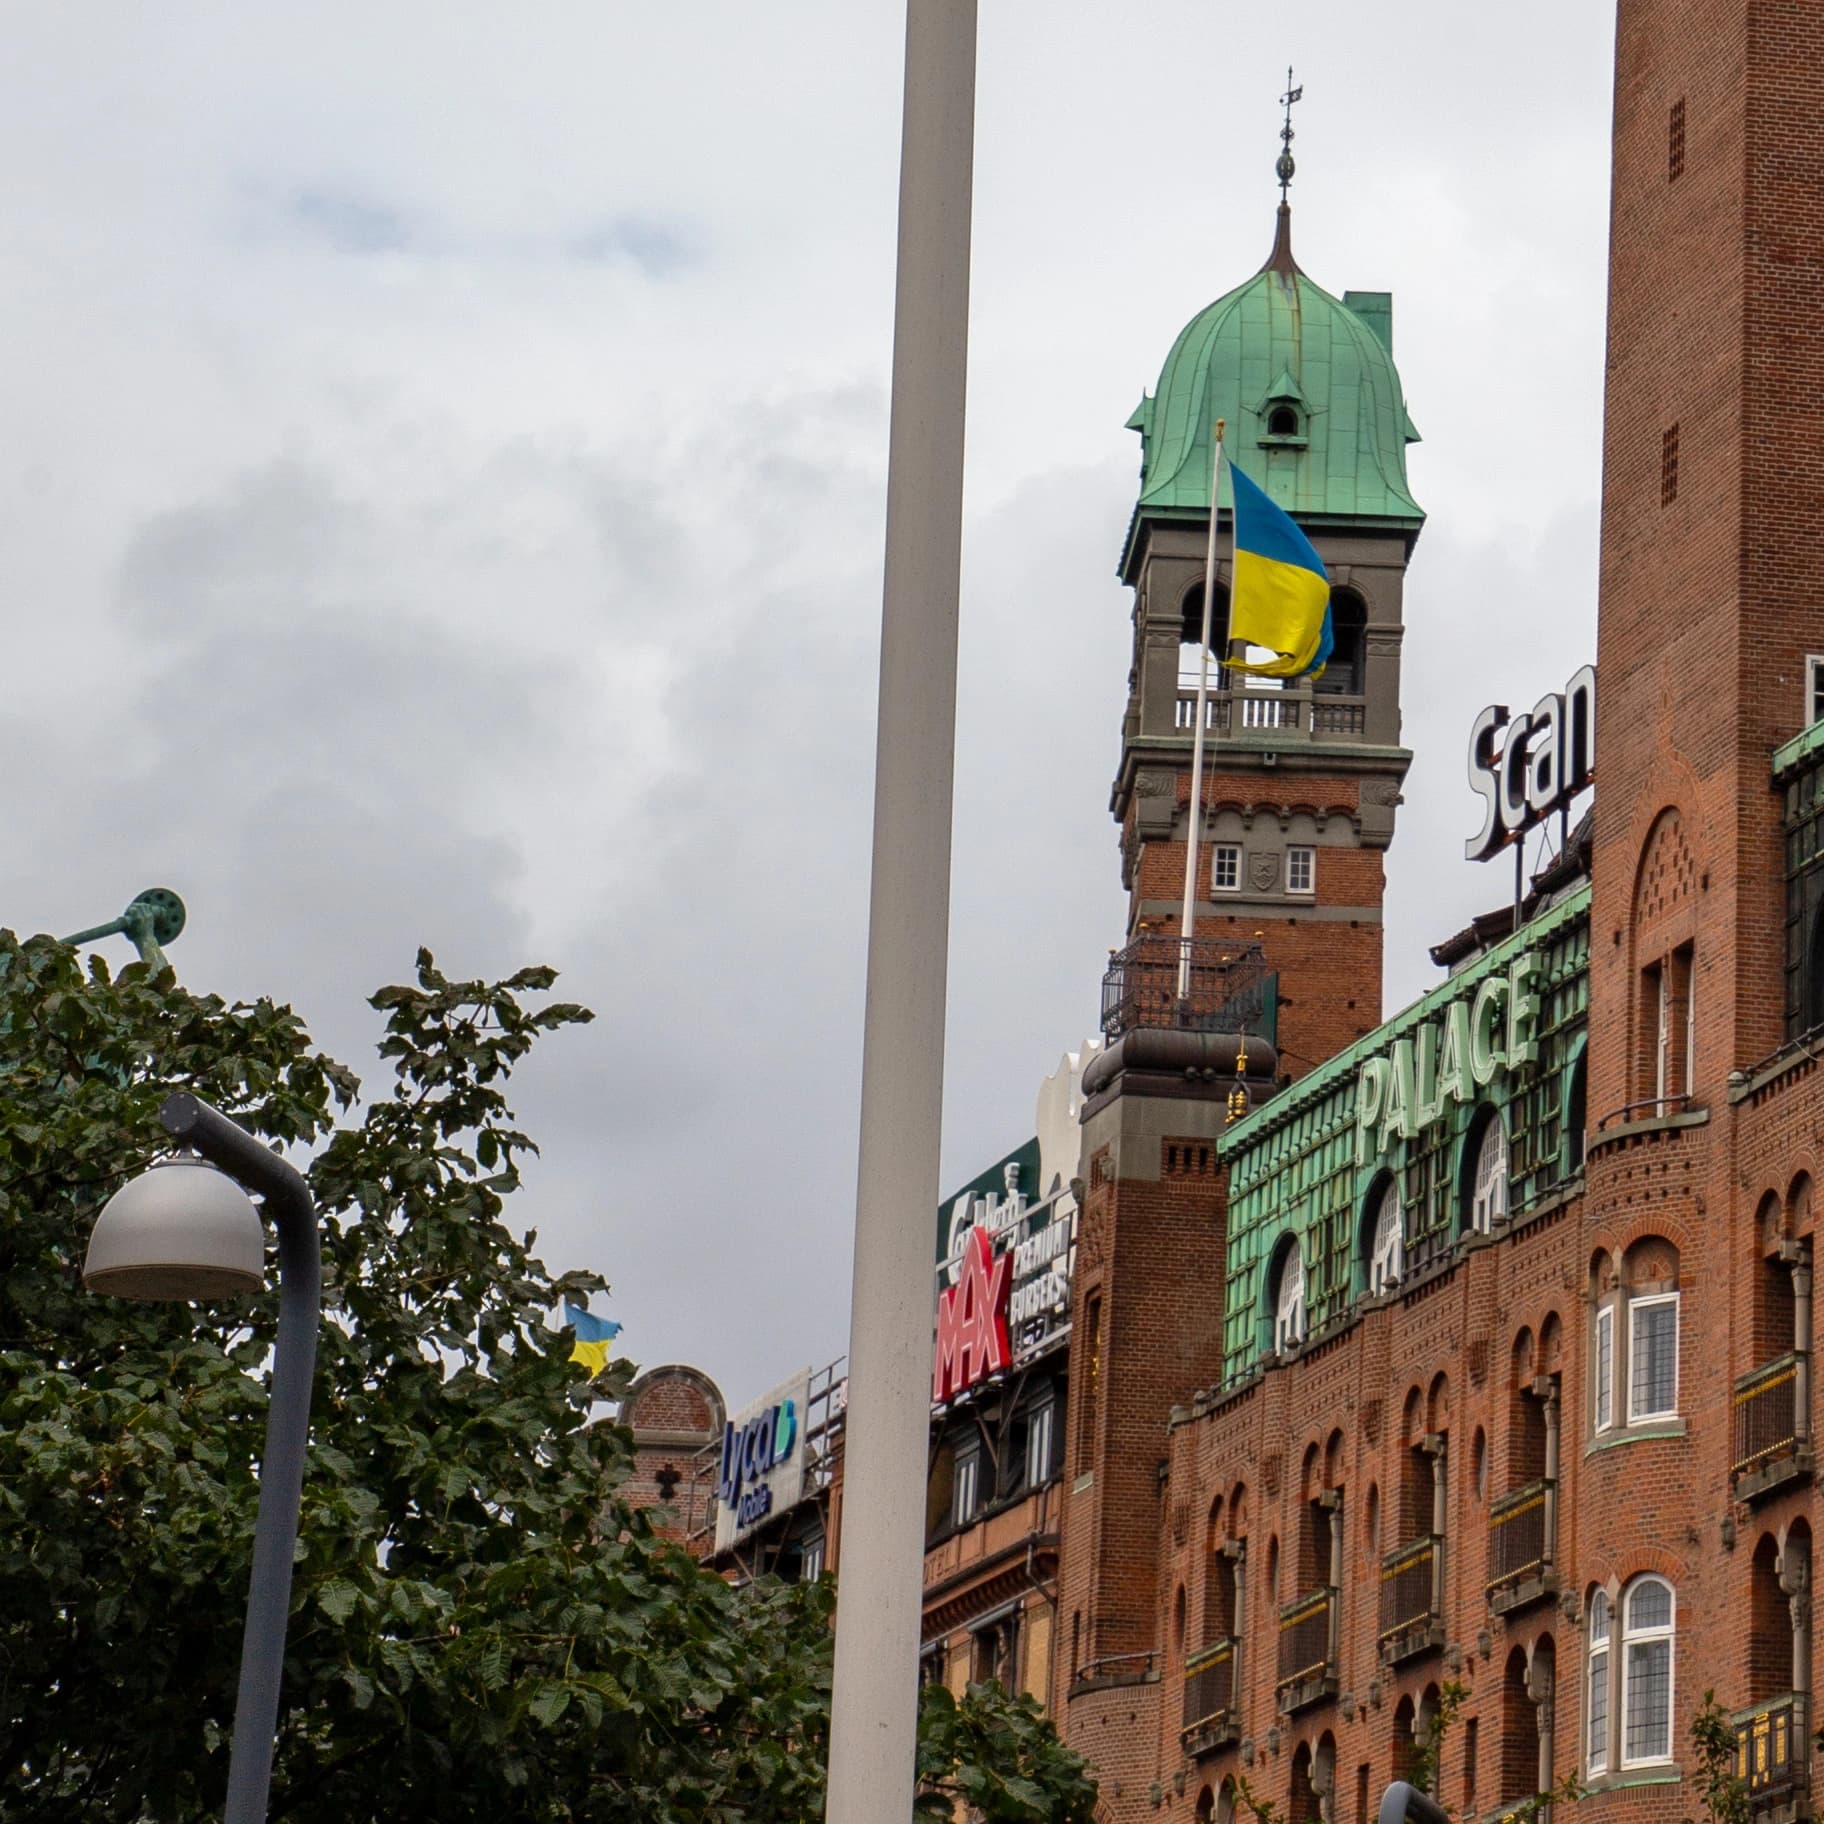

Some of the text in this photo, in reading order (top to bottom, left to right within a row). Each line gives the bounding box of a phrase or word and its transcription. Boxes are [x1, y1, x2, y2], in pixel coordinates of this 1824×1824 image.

[1356, 951, 1544, 1167] PALACE
[948, 1190, 1029, 1285] Calberg
[1013, 1219, 1070, 1280] PREMIUM
[933, 1226, 1013, 1403] MAX
[1010, 1267, 1068, 1327] BURGERS
[719, 1406, 783, 1510] Lyca
[736, 1483, 773, 1530] Mobile
